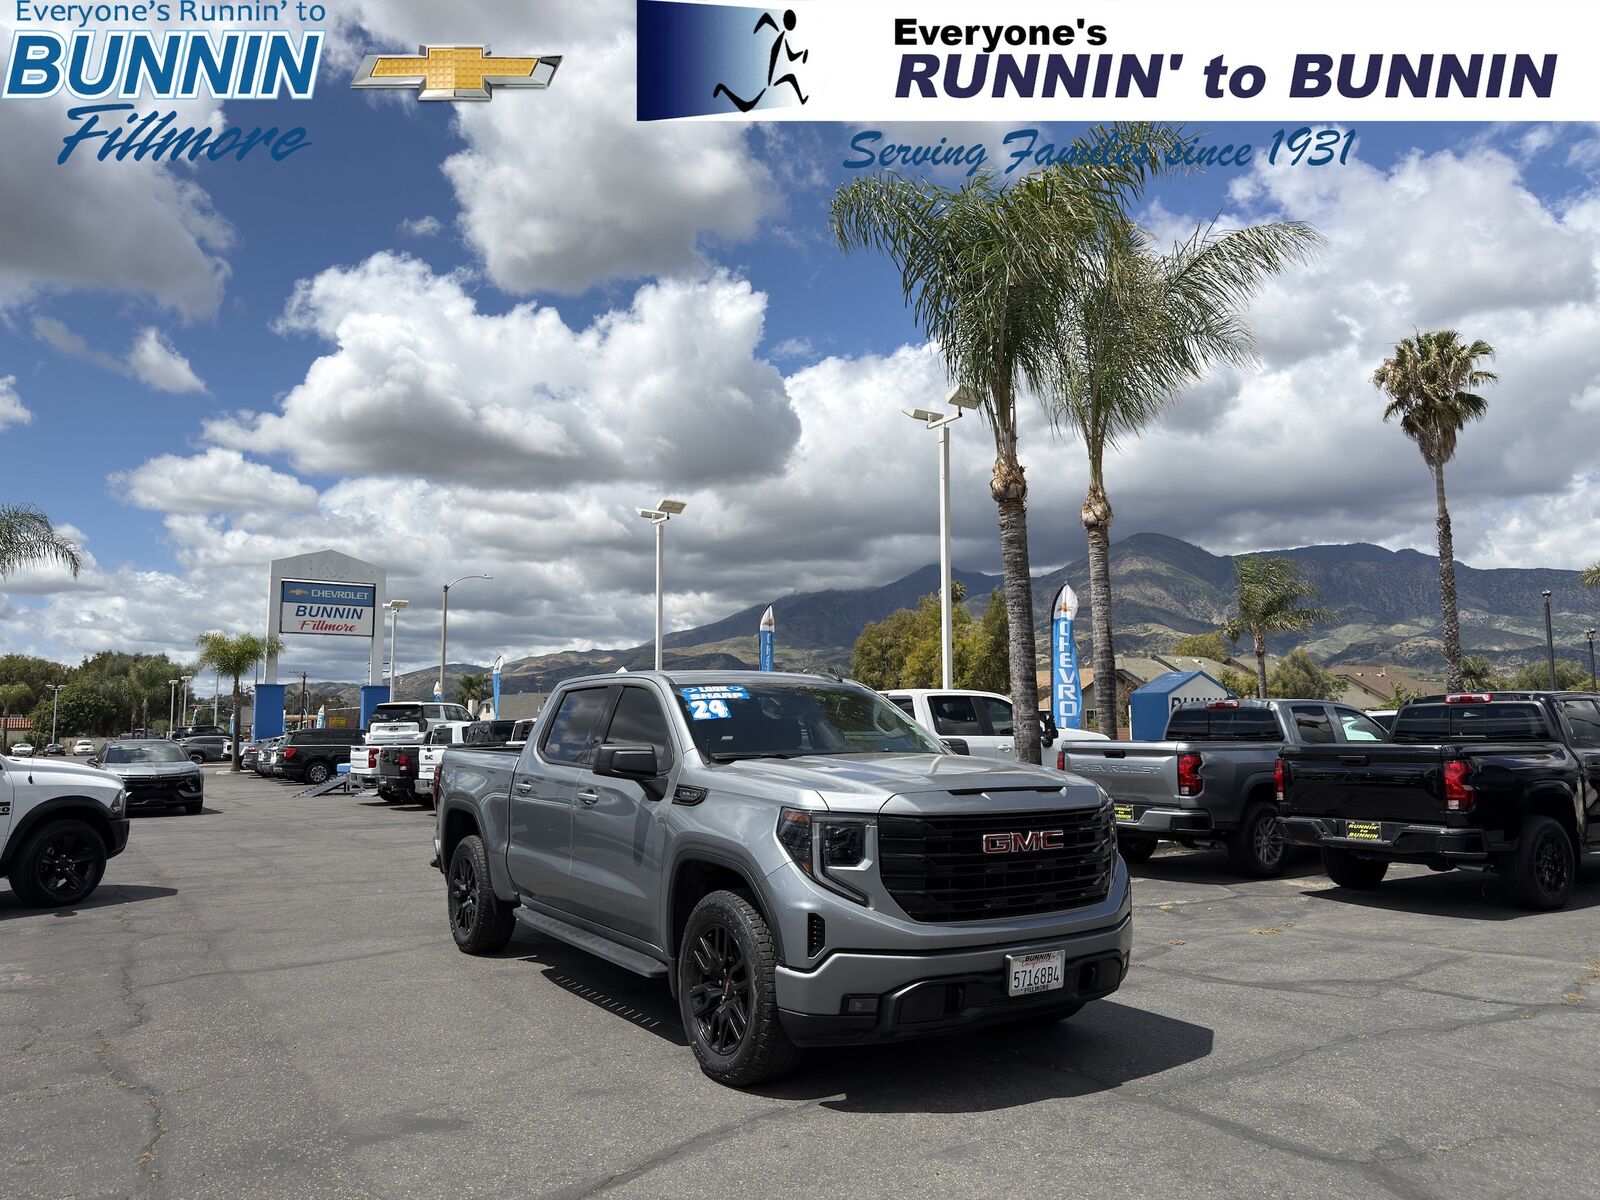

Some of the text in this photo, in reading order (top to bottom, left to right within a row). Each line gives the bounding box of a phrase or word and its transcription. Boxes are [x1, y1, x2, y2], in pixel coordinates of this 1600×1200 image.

[311, 589, 369, 600] CHEVROLET
[295, 605, 364, 620] BUNNIN
[299, 620, 357, 633] Fillmore
[690, 700, 728, 719] 24
[983, 830, 1064, 853] GMC
[1025, 953, 1052, 962] BUNNIN
[1014, 965, 1060, 989] 57168B4
